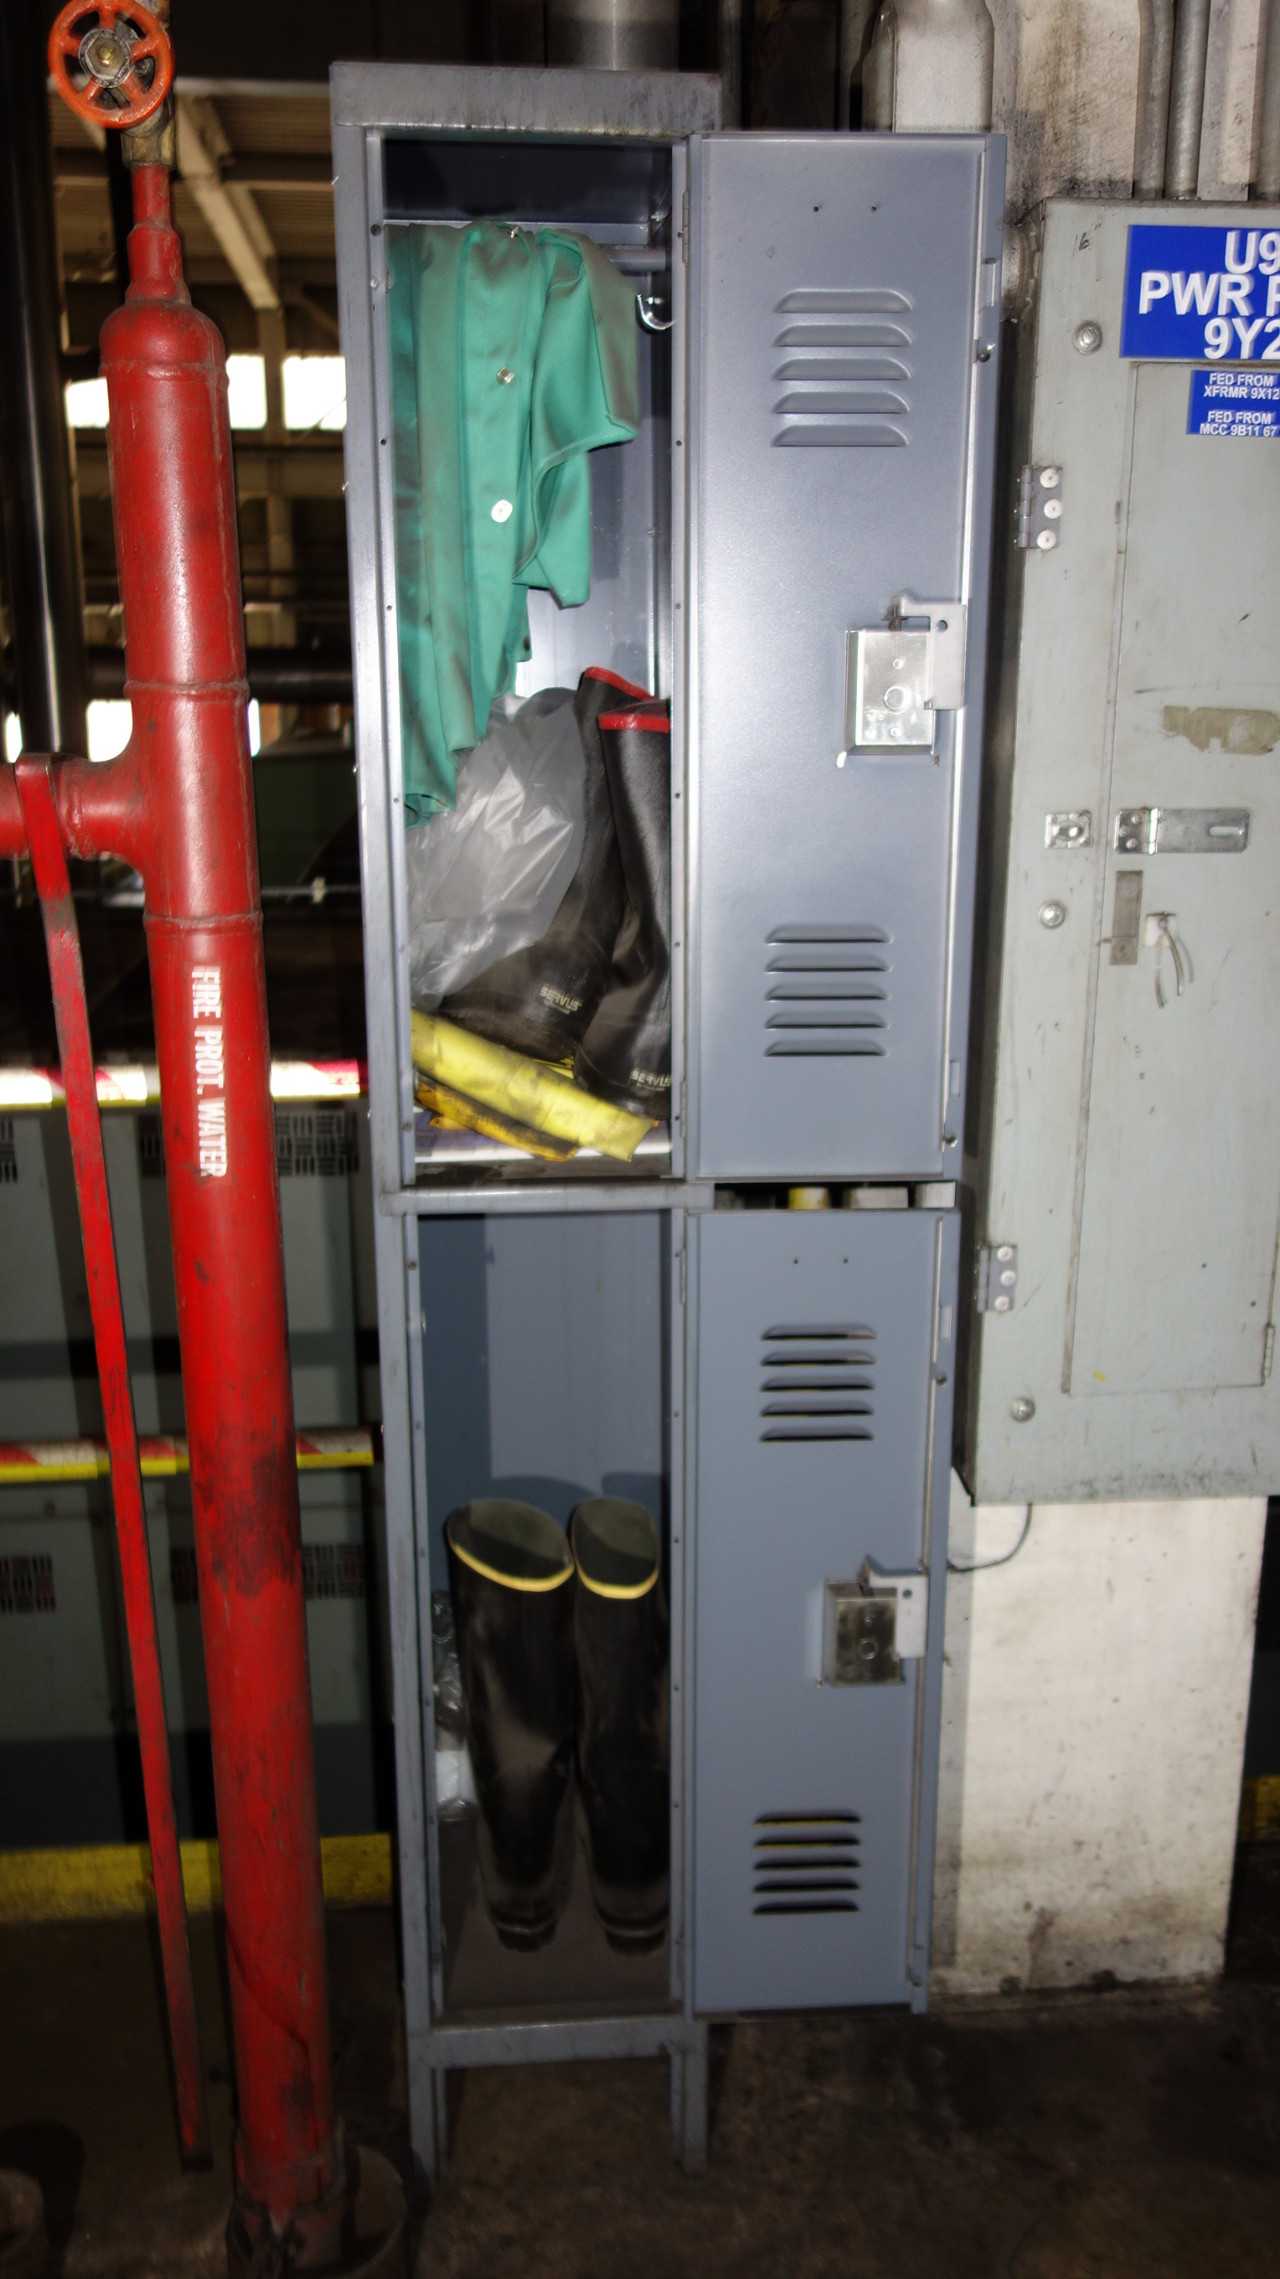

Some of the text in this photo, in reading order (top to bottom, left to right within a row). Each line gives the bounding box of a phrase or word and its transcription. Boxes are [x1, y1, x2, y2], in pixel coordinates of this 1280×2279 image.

[1225, 231, 1280, 275] U9
[1139, 271, 1252, 316] PWR
[1204, 317, 1280, 360] 9Y2
[1203, 385, 1280, 400] XFRMR 9X12
[1209, 373, 1274, 387] FED FROM
[1200, 423, 1277, 437] MCC 9B11 67
[1207, 411, 1273, 425] FED FROM
[540, 984, 580, 1011] SERVUS
[192, 966, 227, 1177] FIRE PROT. WATER
